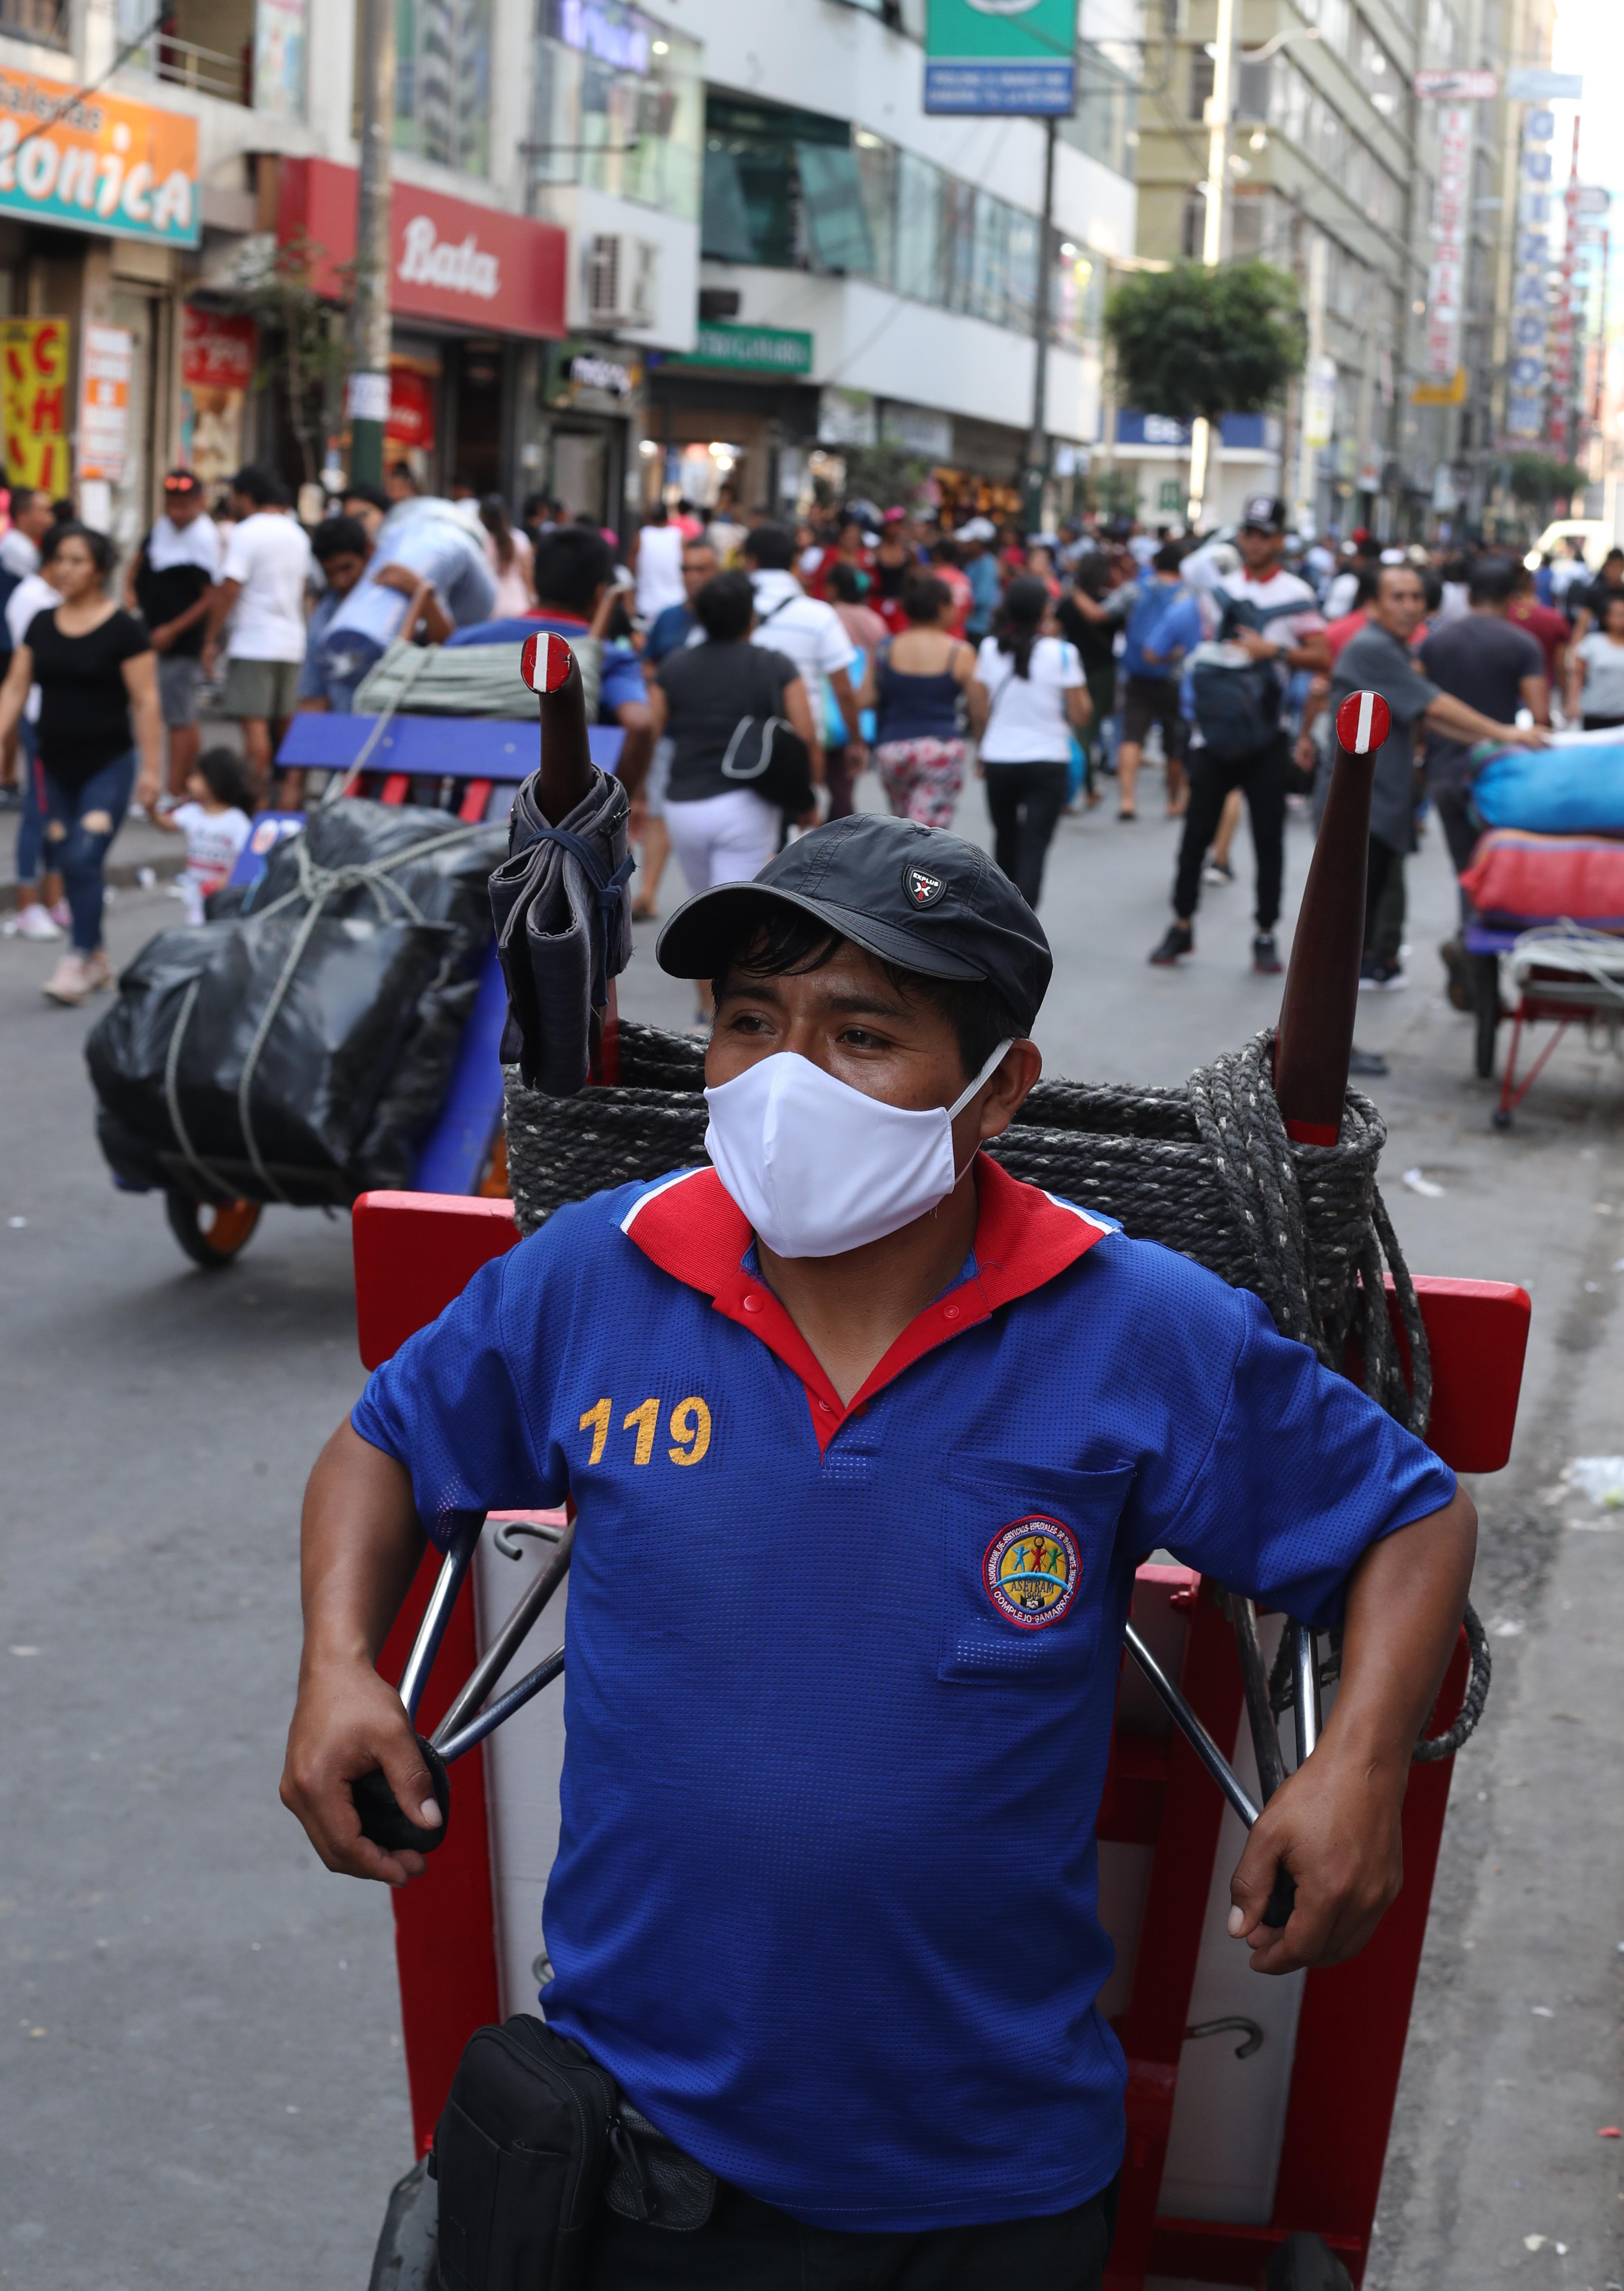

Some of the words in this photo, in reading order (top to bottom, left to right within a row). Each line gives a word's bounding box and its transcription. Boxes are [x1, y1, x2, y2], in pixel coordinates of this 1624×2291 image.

[398, 215, 499, 300] Bata
[913, 872, 939, 887] EXPLUS
[579, 1396, 712, 1466] 119
[988, 1550, 1000, 1585] ASOCIACION
[996, 1541, 1005, 1553] DE
[1003, 1524, 1029, 1543] SERVICIOS
[1057, 1530, 1065, 1540] DE
[994, 1591, 1032, 1622] COMPLEJO
[1034, 1594, 1070, 1623] GAMARRA
[1011, 1580, 1054, 1594] ASETRAM
